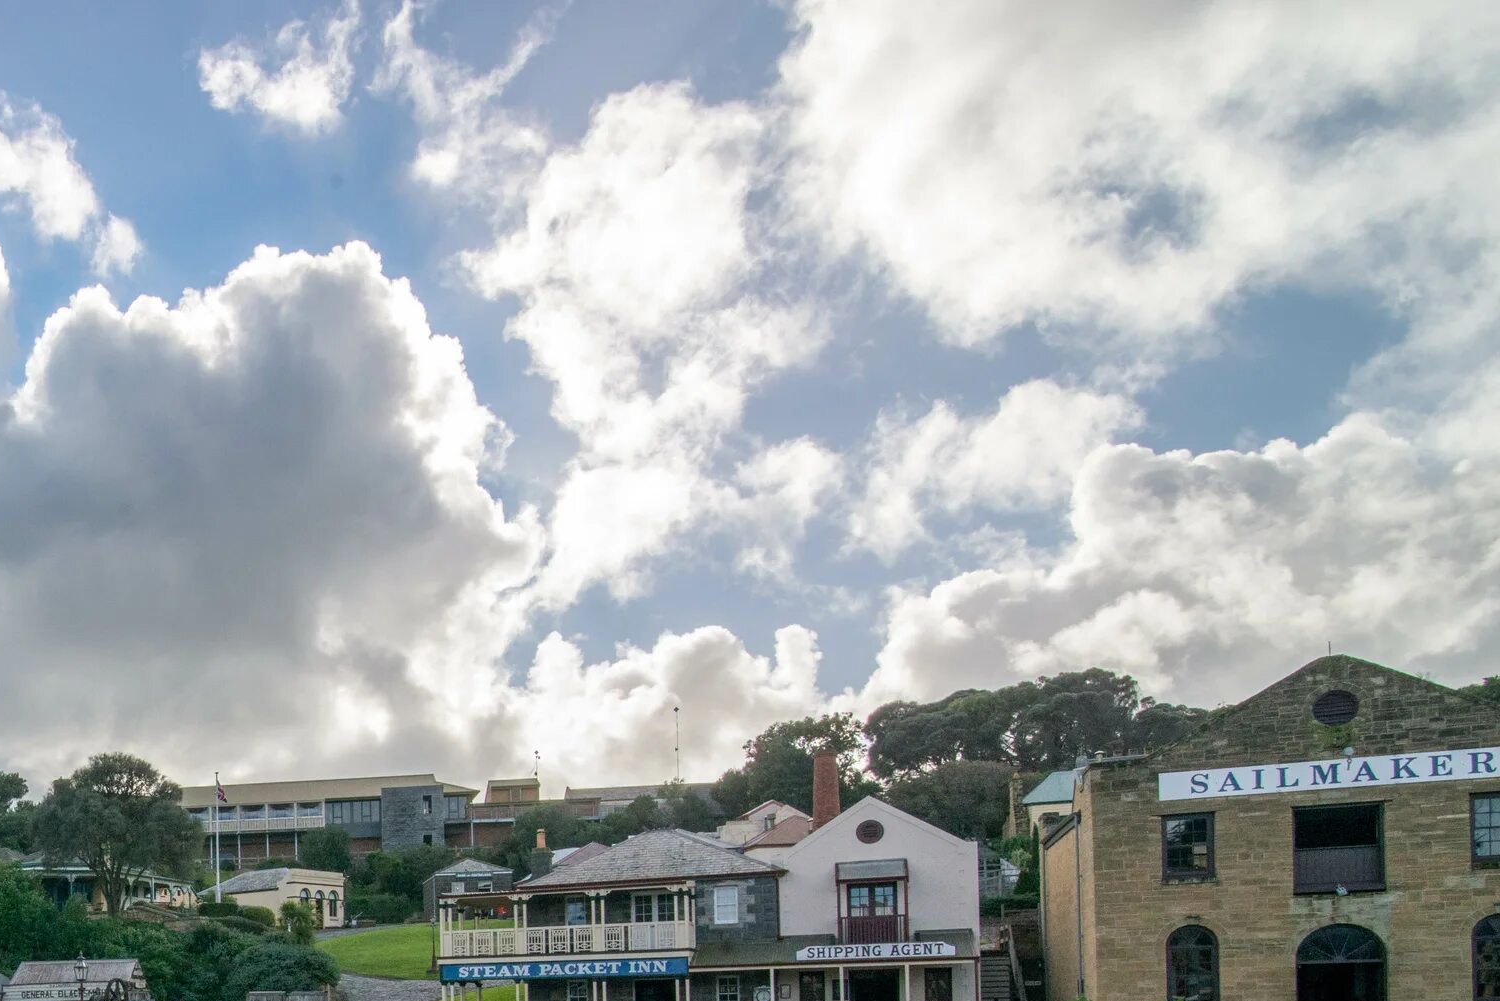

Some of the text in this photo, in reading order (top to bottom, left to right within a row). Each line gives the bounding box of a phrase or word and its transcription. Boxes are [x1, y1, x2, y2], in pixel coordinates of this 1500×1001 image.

[1190, 751, 1498, 794] SAILMAKER
[807, 943, 944, 959] SHIPPING AGENT
[458, 960, 669, 978] STEAM PACKET INN
[21, 989, 55, 999] GENERAL
